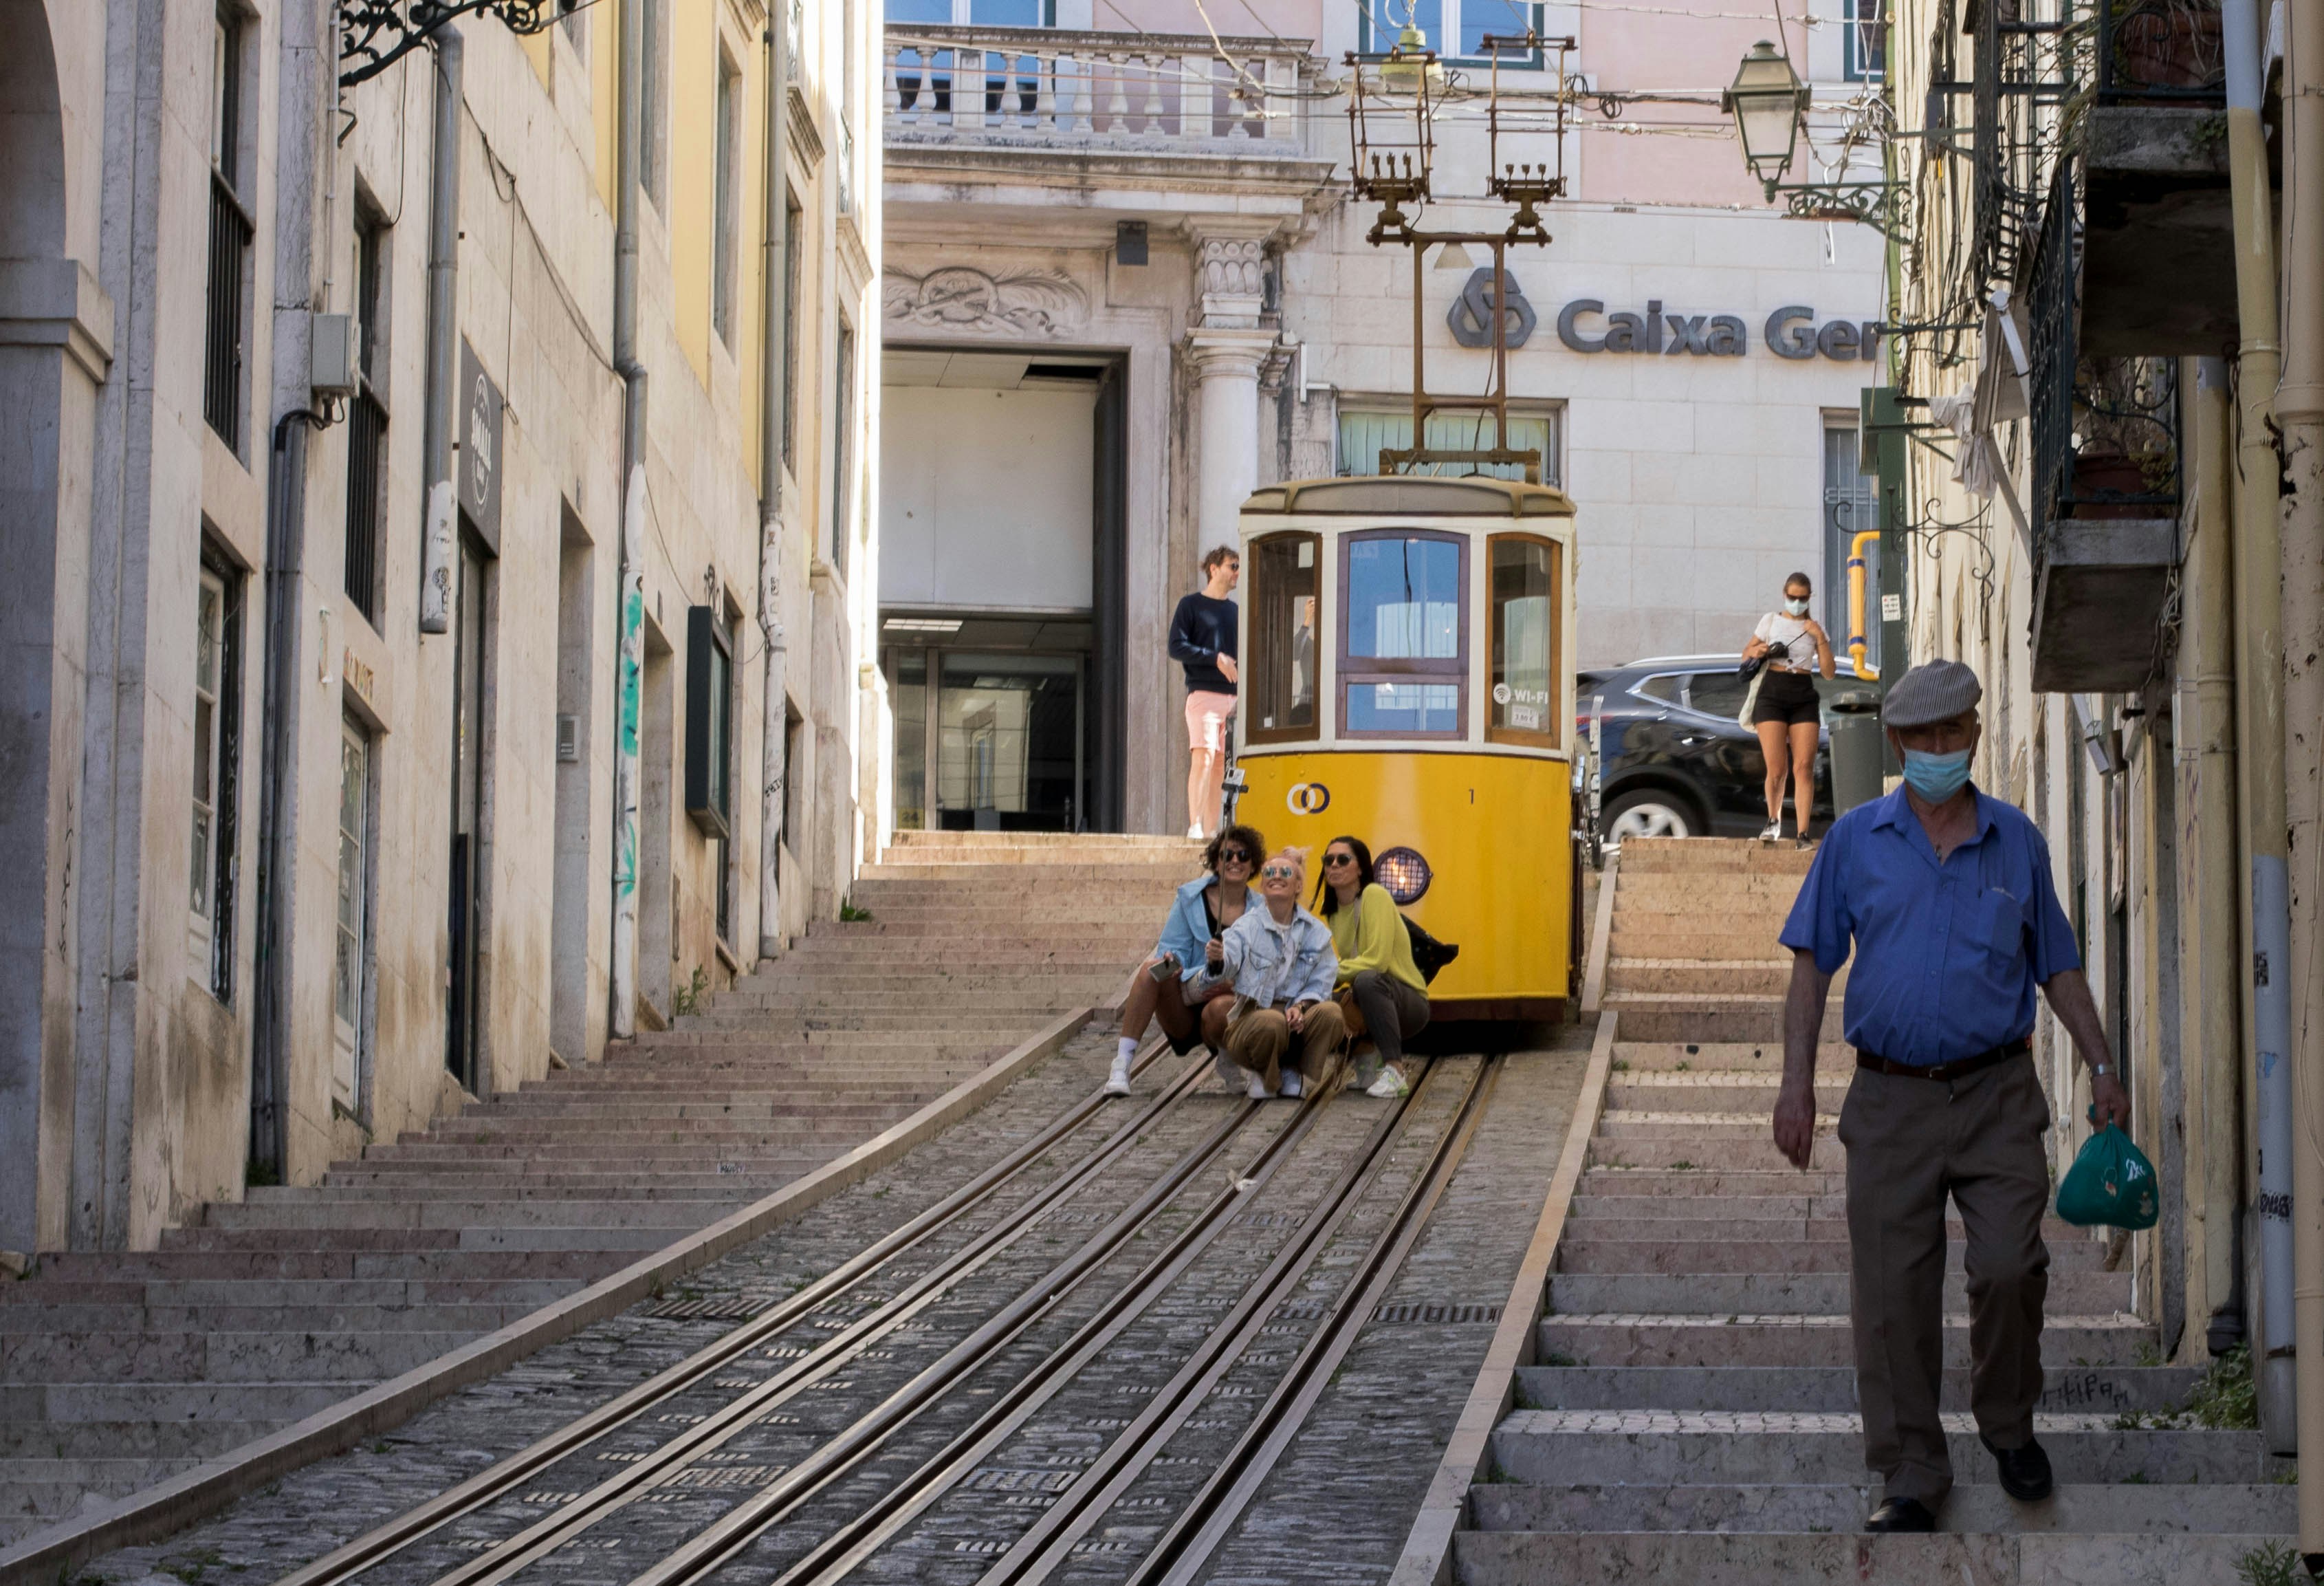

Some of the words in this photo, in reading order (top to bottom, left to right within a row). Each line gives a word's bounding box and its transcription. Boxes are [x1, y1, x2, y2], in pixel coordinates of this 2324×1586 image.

[1557, 298, 1747, 356] Caixa
[471, 407, 492, 472] SMALL
[1514, 689, 1548, 705] WI-FI
[1468, 788, 1474, 804] 1
